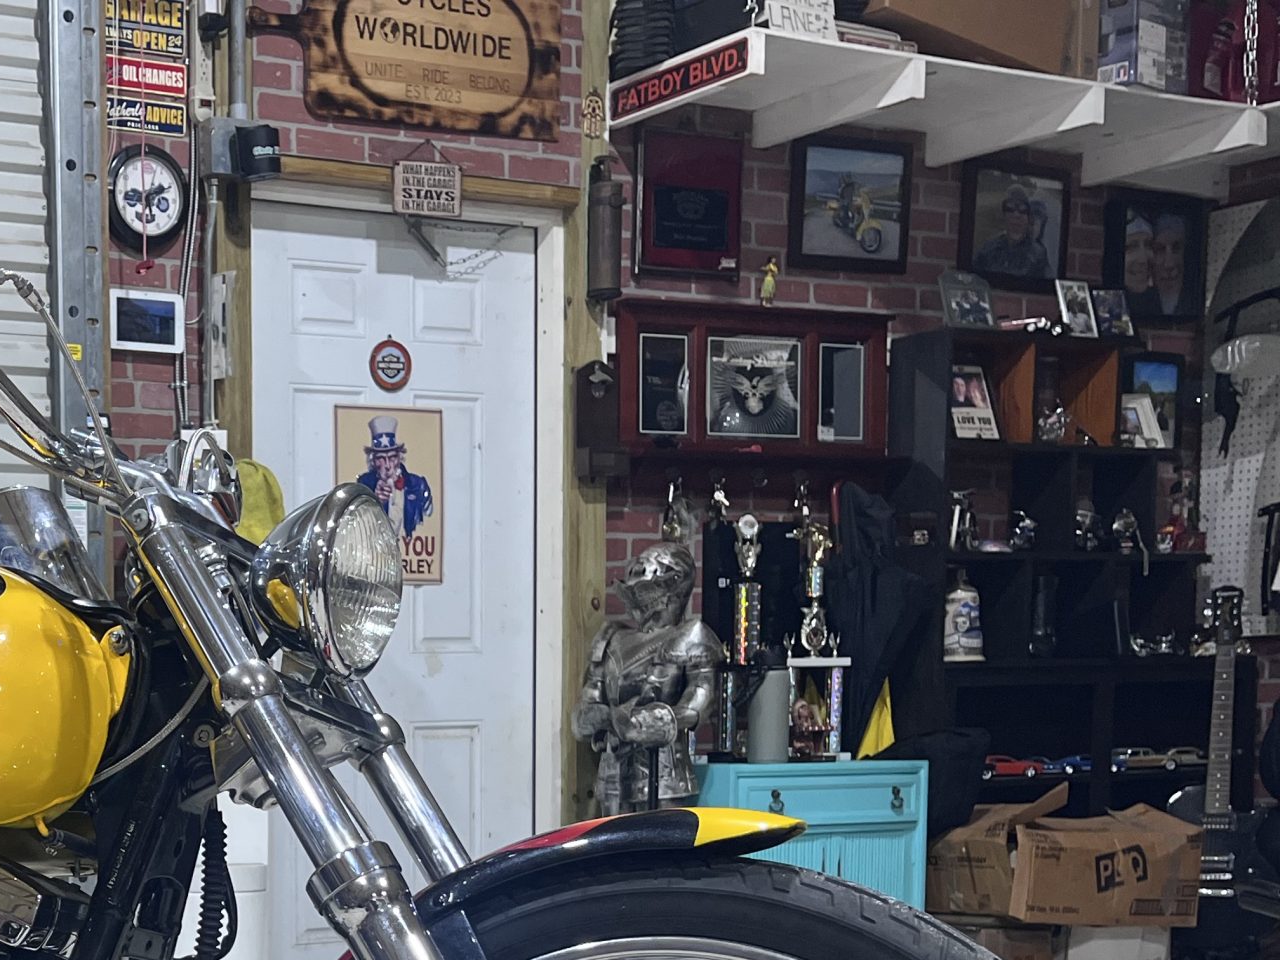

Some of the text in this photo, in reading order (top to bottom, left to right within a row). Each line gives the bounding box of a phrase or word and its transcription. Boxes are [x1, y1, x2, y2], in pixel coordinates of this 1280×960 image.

[105, 26, 132, 39] LWAYS
[132, 30, 167, 51] OPEN
[168, 36, 182, 47] 24
[122, 65, 138, 82] OIL
[138, 67, 183, 88] CHANGES
[365, 61, 511, 92] UNITE RIDE BELONG
[618, 48, 743, 113] FATBOY BLVD.
[435, 88, 462, 104] 2023
[145, 105, 183, 126] ADVICE
[127, 121, 159, 131] PRICLESS
[402, 163, 456, 177] WHAT HAPPENS
[402, 175, 456, 189] IN THE GARAGE
[402, 188, 455, 202] STAYS
[402, 200, 456, 214] IN THE GARAGE
[957, 416, 991, 425] LOVE YOU
[402, 535, 435, 557] YOU
[401, 558, 434, 575] RLEY
